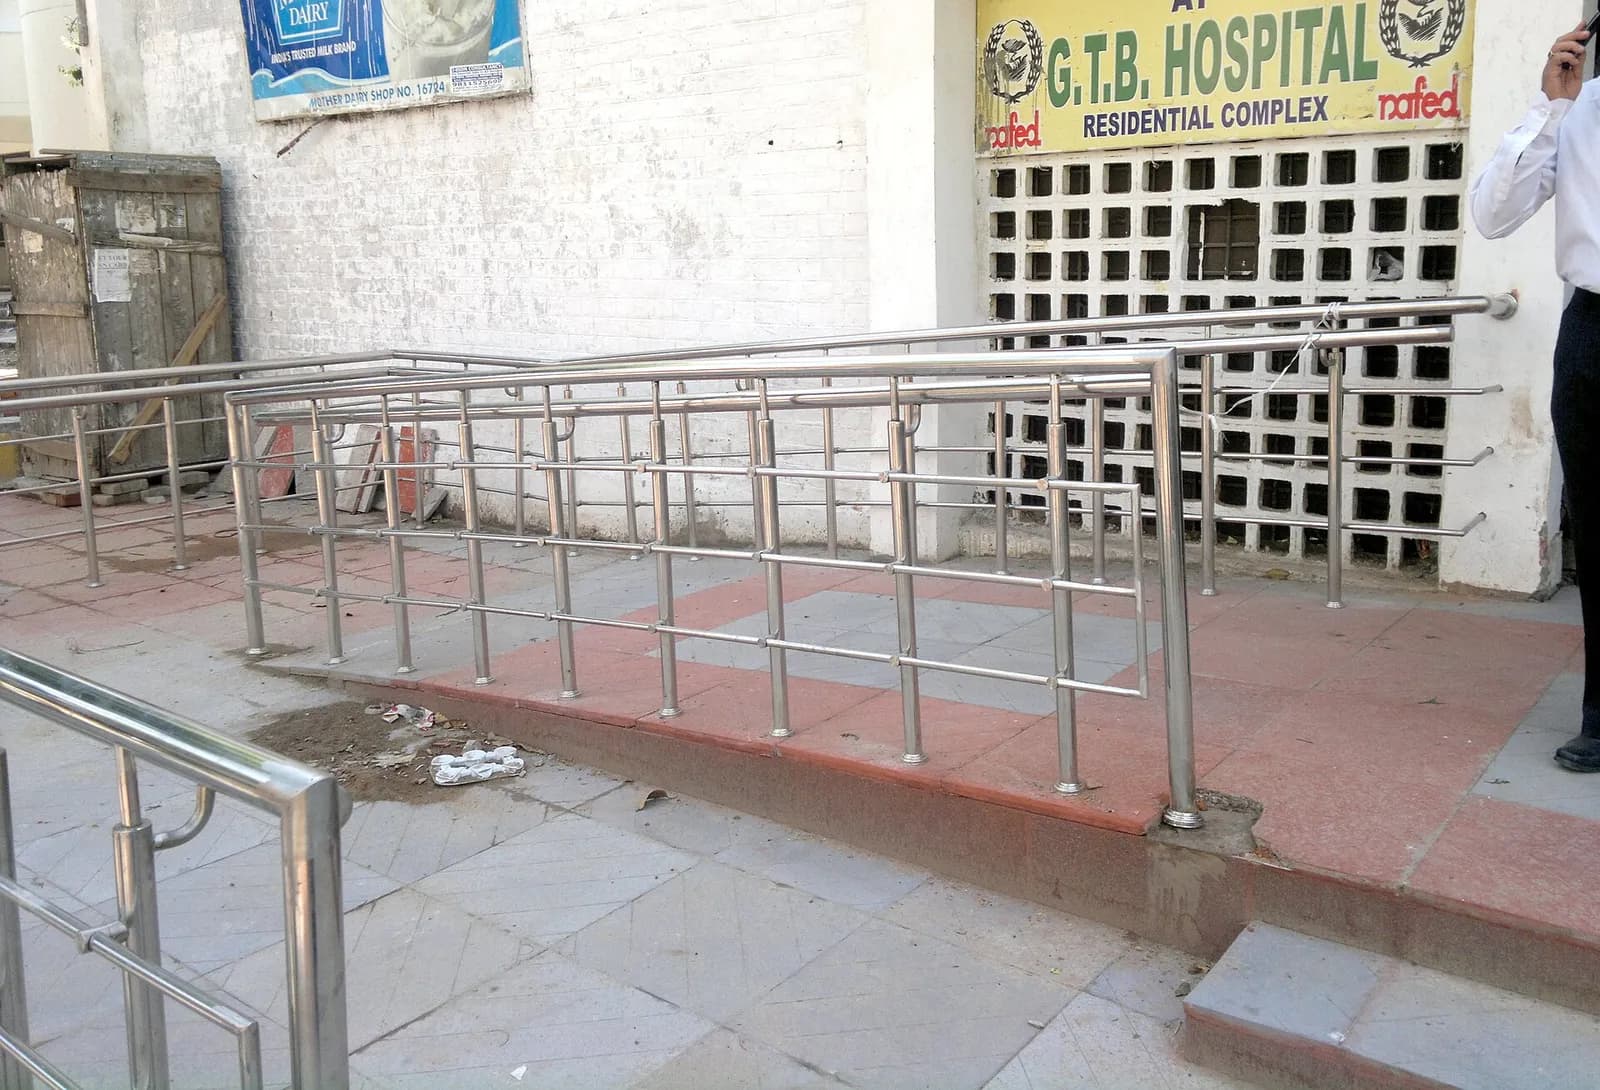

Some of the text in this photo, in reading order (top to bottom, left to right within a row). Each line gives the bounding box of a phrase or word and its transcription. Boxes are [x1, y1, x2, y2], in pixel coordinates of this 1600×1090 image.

[288, 1, 329, 26] DAIRY
[291, 47, 316, 61] TRUSTED
[317, 44, 333, 57] MILK
[334, 40, 357, 54] BRAND
[1047, 2, 1379, 108] G.T.B. HOSPITAL
[309, 95, 343, 108] MOTHER
[345, 91, 369, 104] DAIRY
[371, 88, 395, 102] SHOP
[397, 84, 415, 98] NO.
[1378, 75, 1460, 121] nafed
[1083, 95, 1329, 139] RESIDENTIAL COMPLEX
